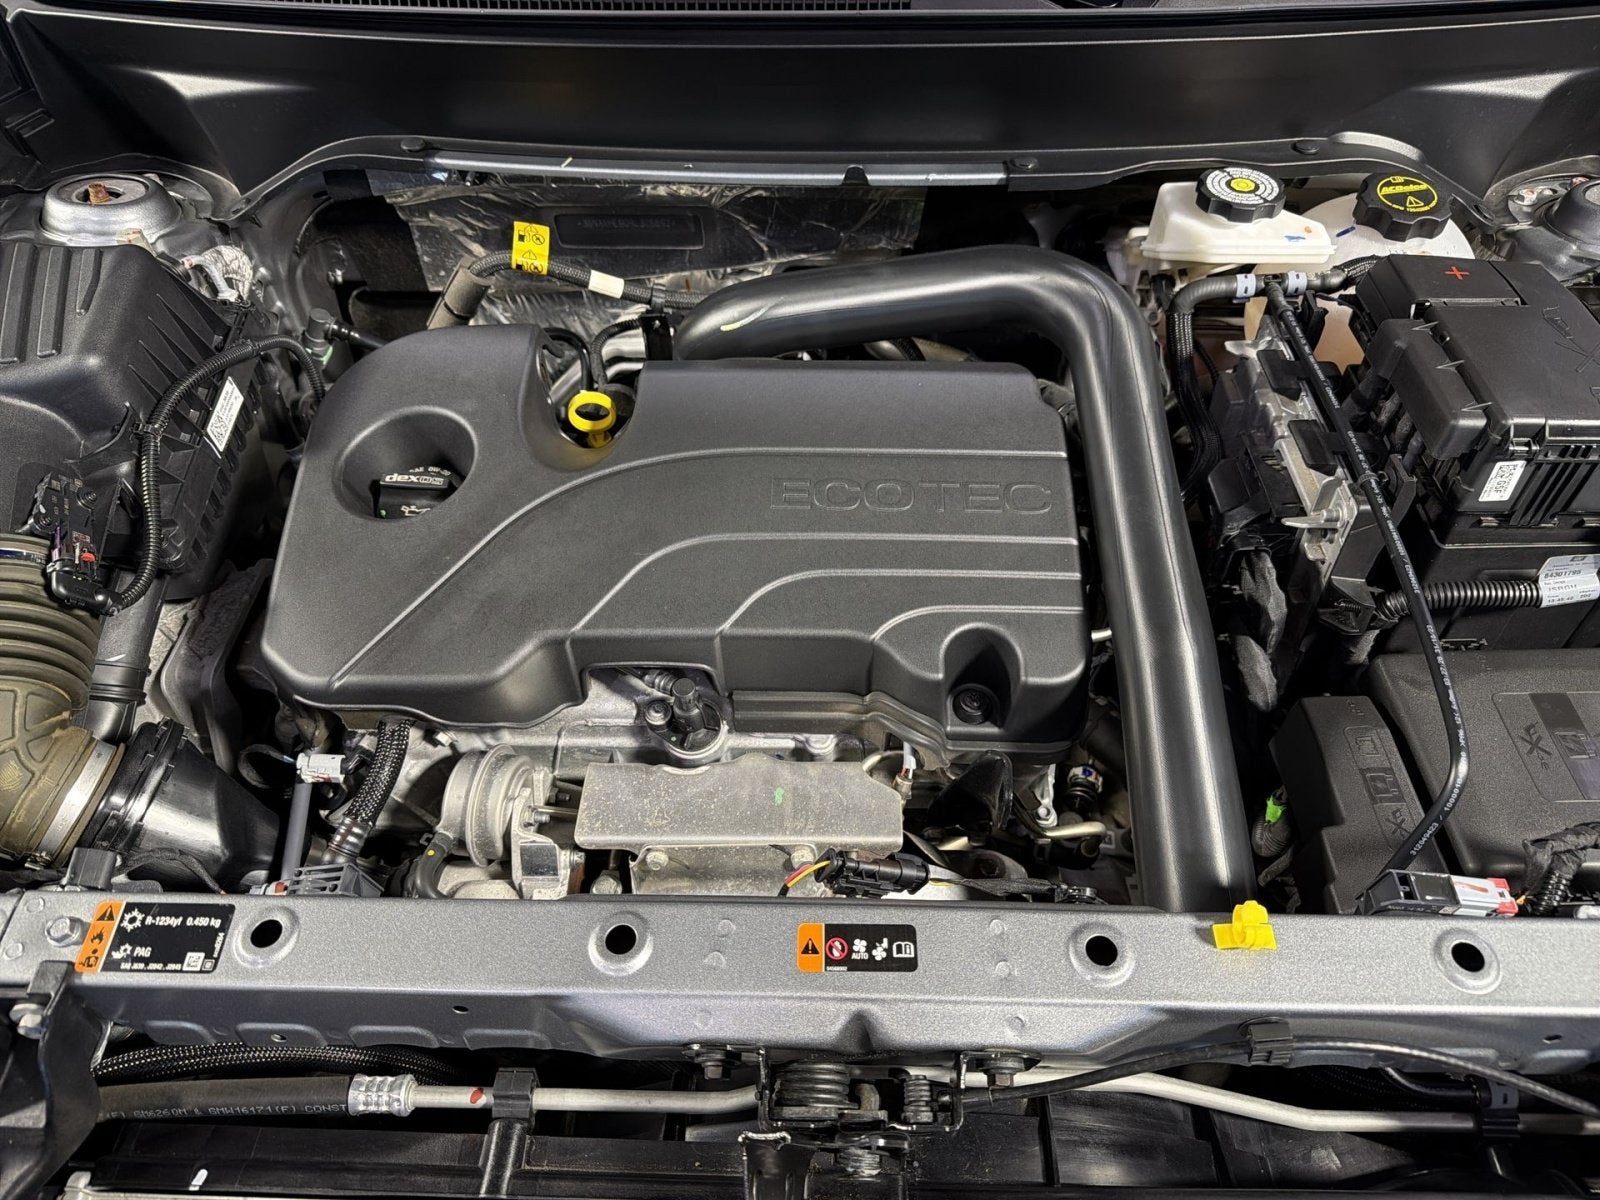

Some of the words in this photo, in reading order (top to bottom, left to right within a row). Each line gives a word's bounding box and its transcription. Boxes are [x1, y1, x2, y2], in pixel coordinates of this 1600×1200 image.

[385, 473, 444, 485] dexos
[770, 478, 1052, 515] ECOTEC
[1410, 822, 1439, 856] 312049423
[145, 916, 183, 928] R-1234yf
[186, 916, 209, 926] 0.450
[210, 917, 222, 928] kg
[133, 946, 152, 958] PAG
[851, 952, 869, 960] AUTO
